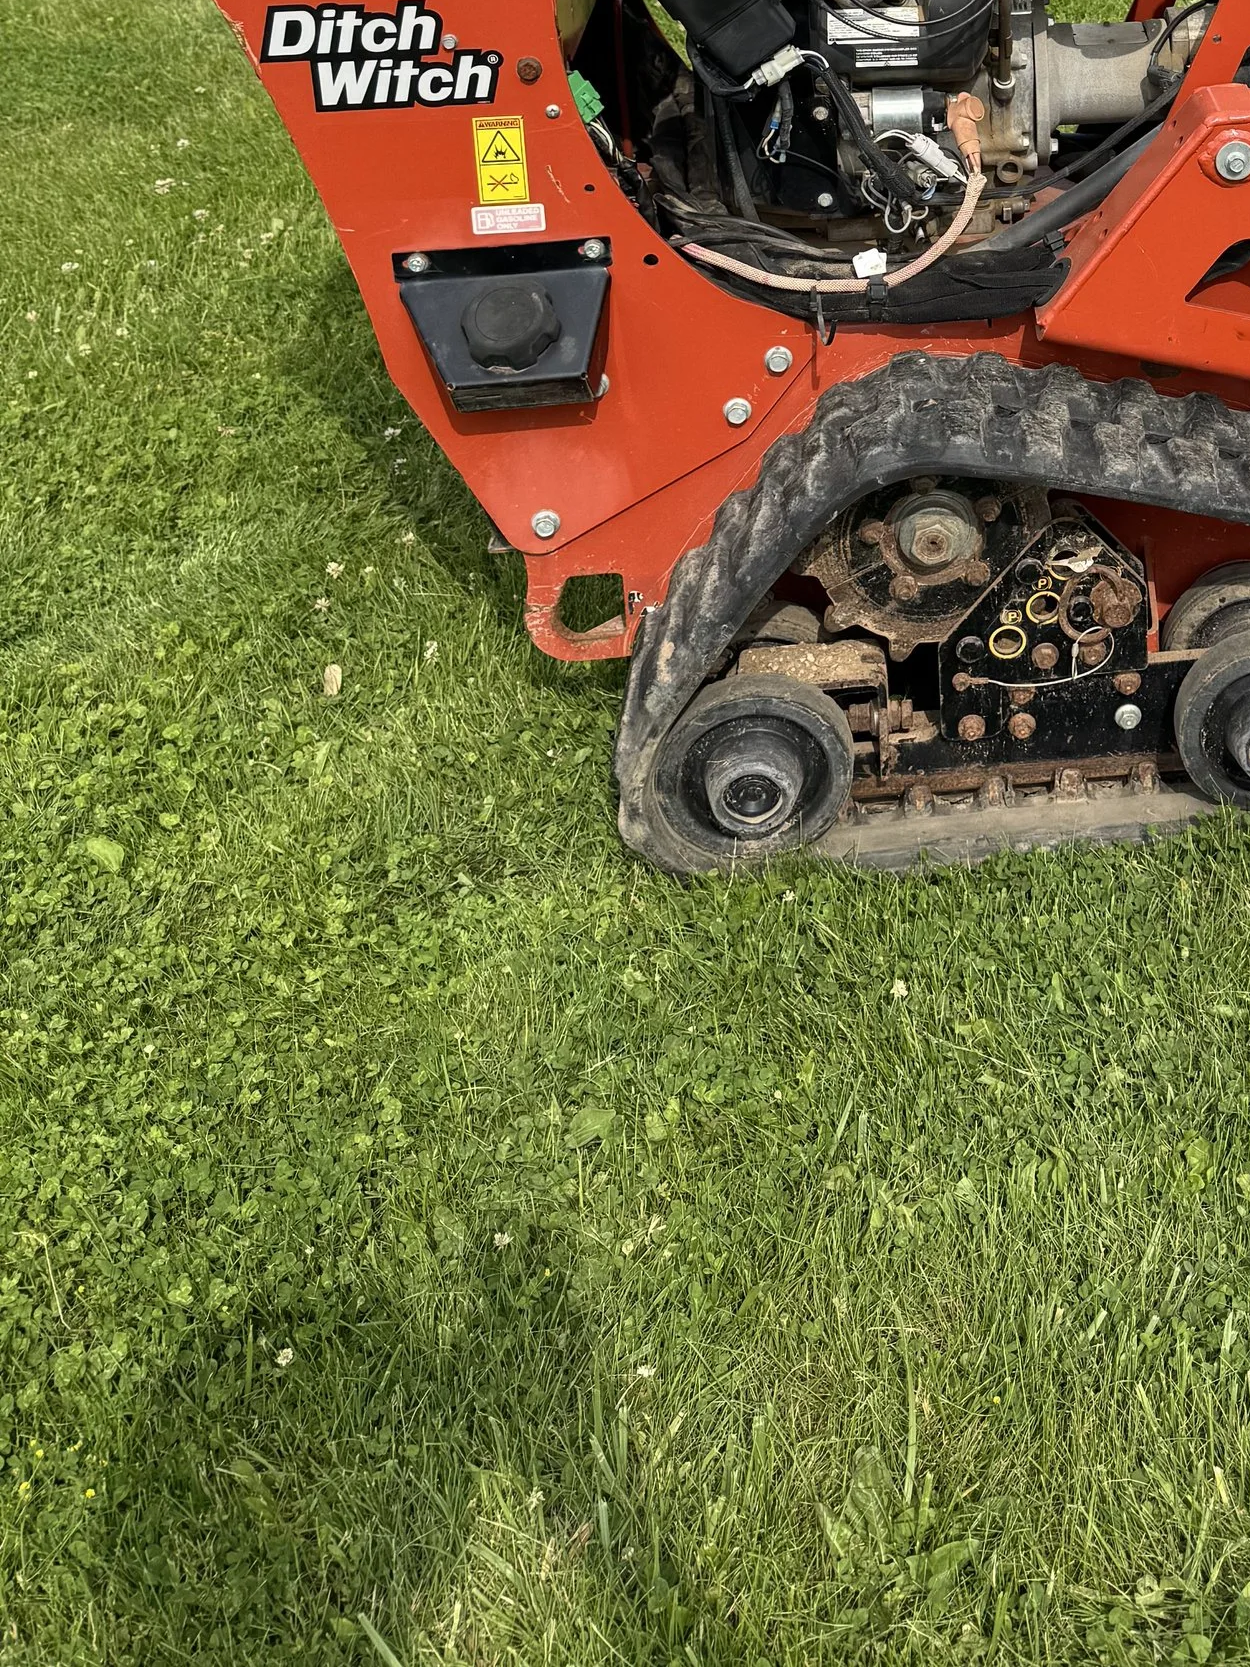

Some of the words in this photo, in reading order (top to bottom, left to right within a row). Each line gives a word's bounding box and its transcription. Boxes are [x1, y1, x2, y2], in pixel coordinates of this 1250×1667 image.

[268, 5, 436, 56] Ditch
[484, 120, 519, 128] WARNING
[495, 207, 540, 216] UNLEADED
[496, 214, 538, 223] GASOLINE
[496, 222, 519, 231] ONLY
